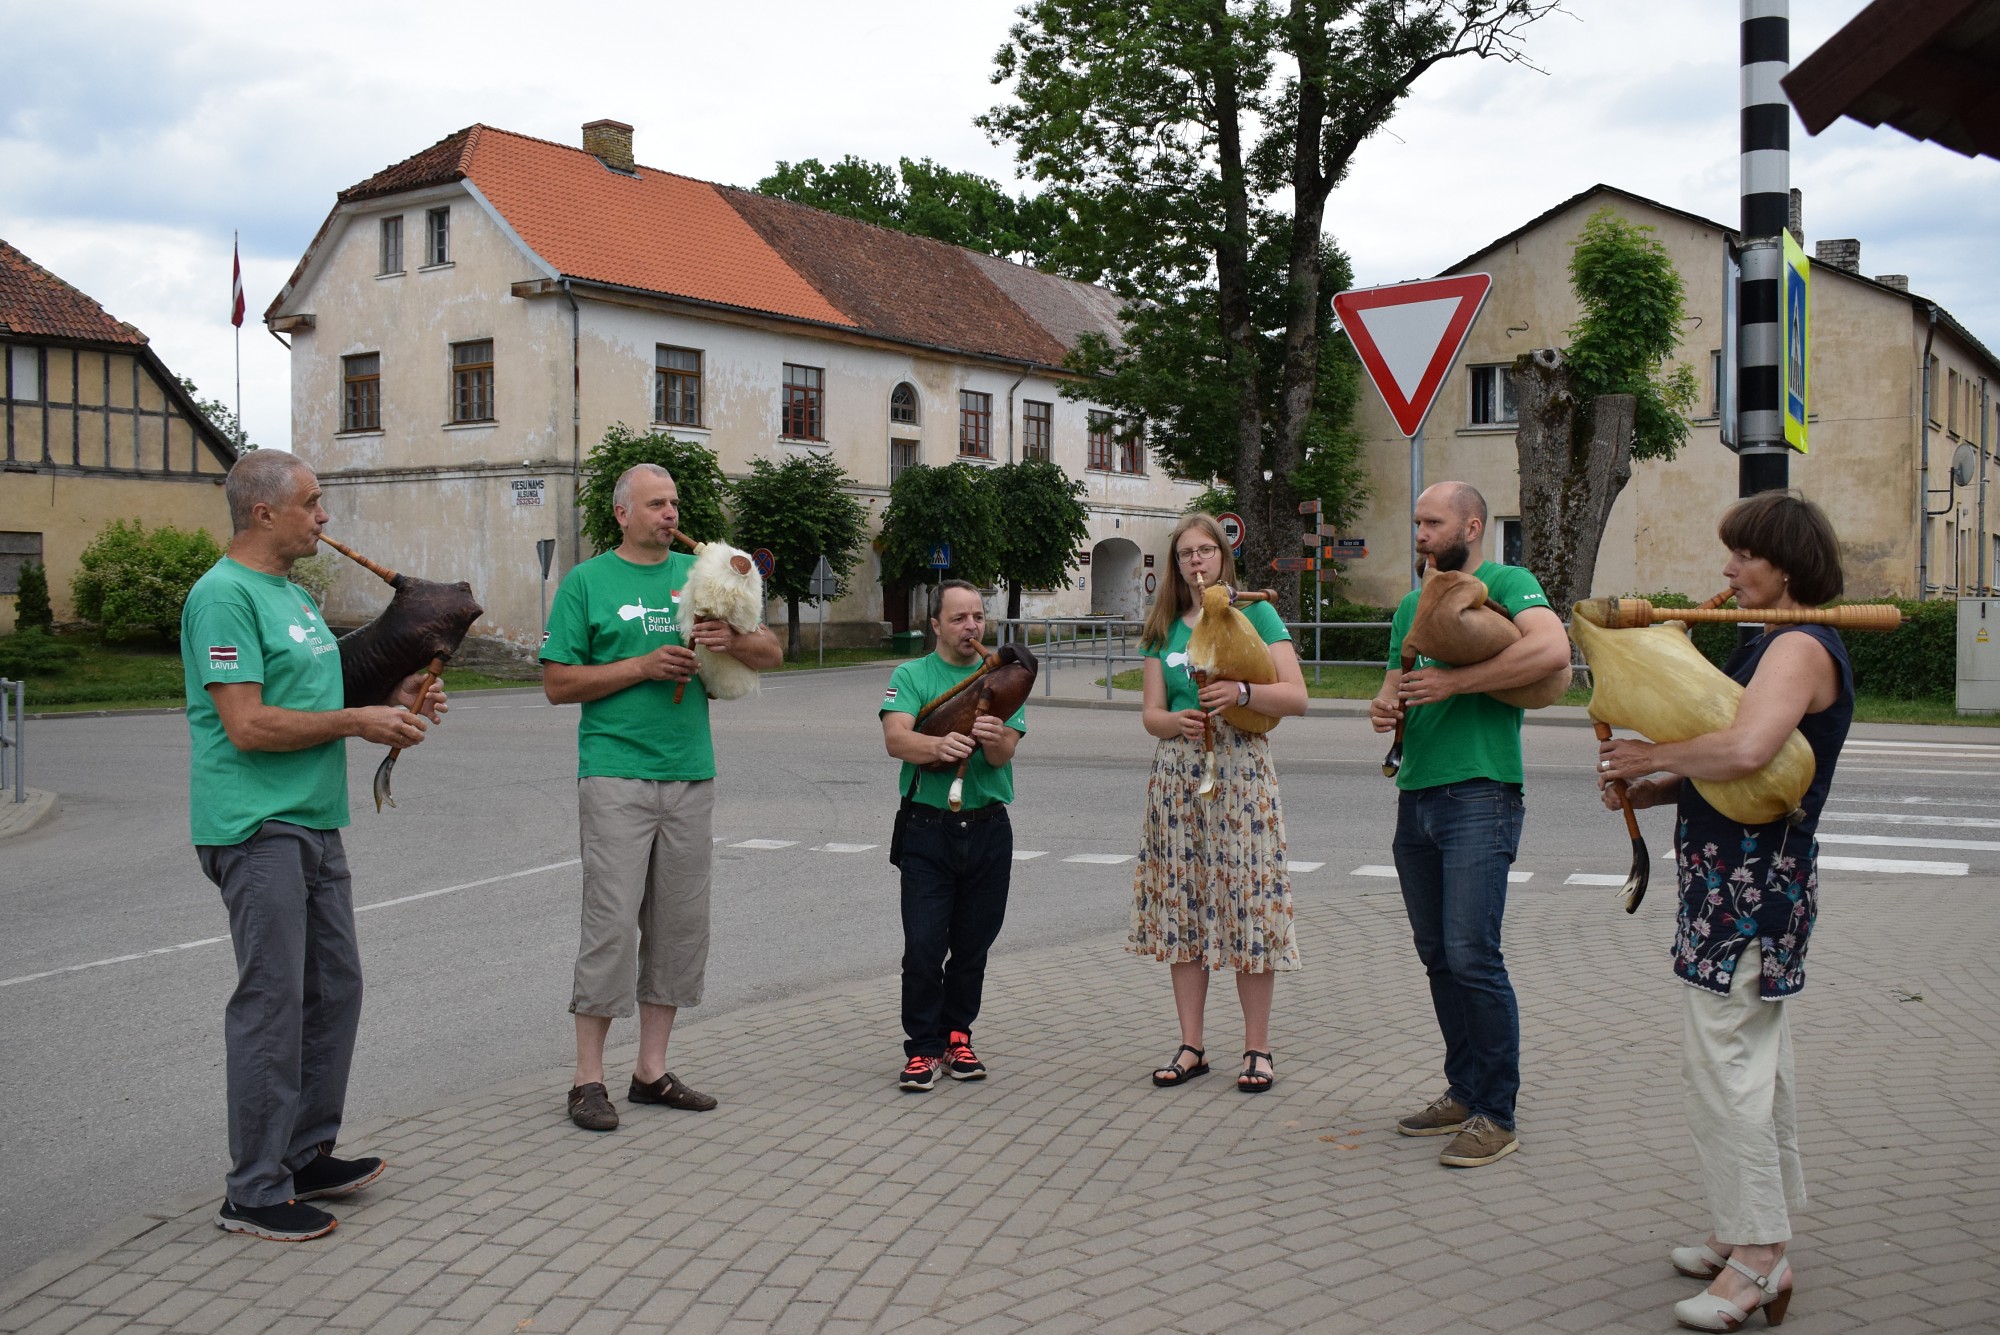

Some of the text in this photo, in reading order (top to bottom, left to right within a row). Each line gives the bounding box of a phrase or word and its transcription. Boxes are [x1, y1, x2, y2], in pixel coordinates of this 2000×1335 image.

[511, 479, 545, 490] VIESU NAMS
[648, 615, 671, 624] SUITU
[210, 661, 239, 670] LATVIJA
